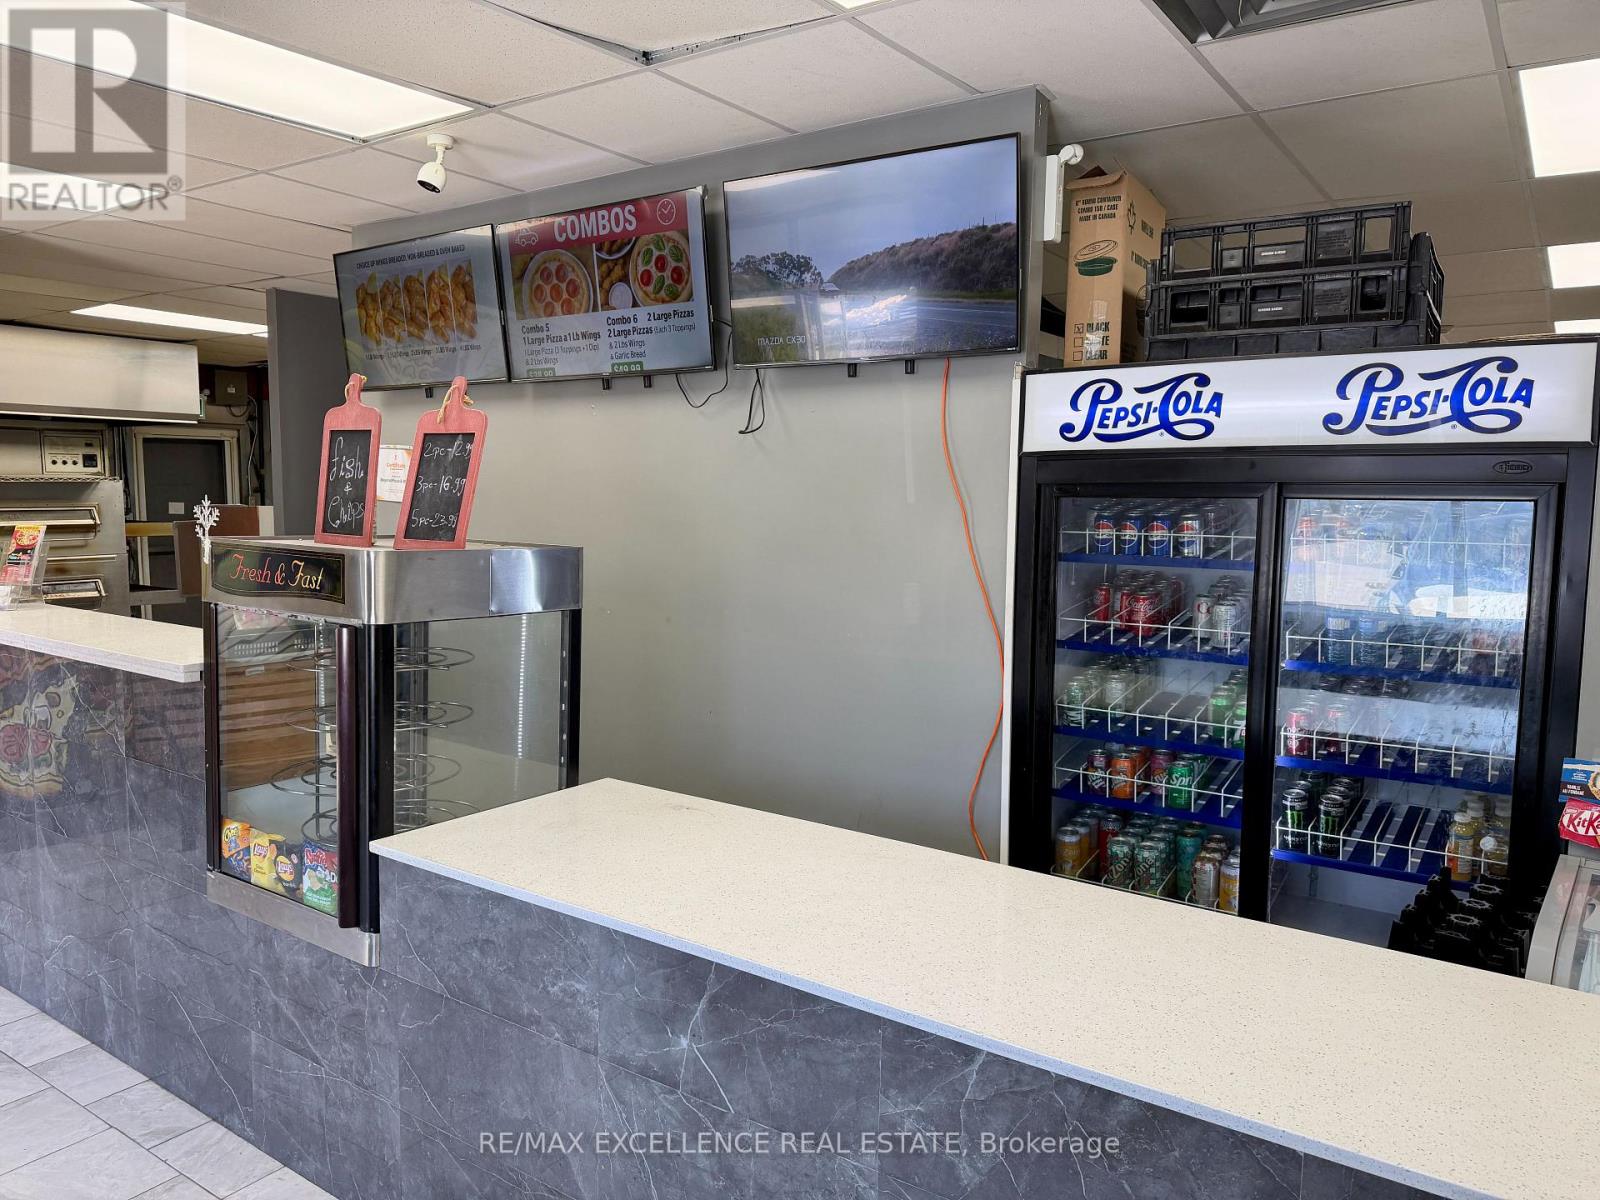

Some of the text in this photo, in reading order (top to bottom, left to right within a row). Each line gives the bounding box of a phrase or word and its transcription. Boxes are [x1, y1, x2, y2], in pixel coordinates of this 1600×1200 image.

[1098, 212, 1116, 220] CANADA
[554, 205, 637, 242] COMBOS
[606, 313, 638, 326] Combo 6
[647, 308, 695, 322] 2 Large Pizzas
[521, 323, 550, 334] Combo 5
[607, 328, 612, 338] 2
[613, 327, 631, 339] Large
[632, 325, 653, 336] Pizzas
[1086, 321, 1110, 332] BLACK
[527, 335, 545, 346] Large
[545, 333, 563, 344] Pizza
[572, 331, 580, 341] Lb
[580, 329, 601, 341] Wings
[757, 336, 784, 346] MAZDA
[628, 339, 646, 349] Wings
[614, 350, 630, 360] Garlic
[630, 349, 647, 359] Bread
[230, 553, 324, 590] Fresh & Fast
